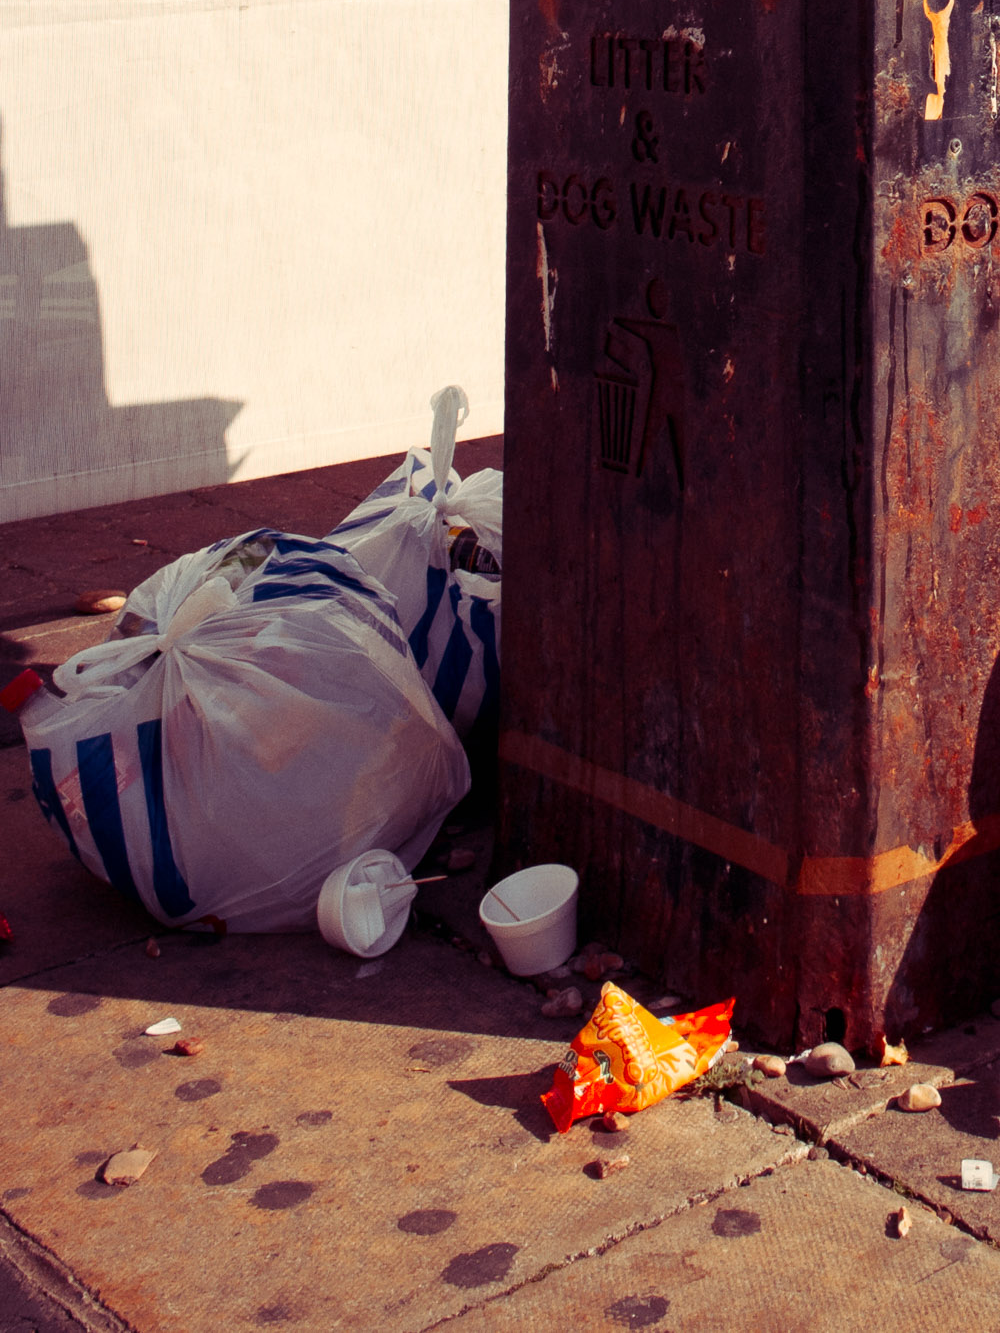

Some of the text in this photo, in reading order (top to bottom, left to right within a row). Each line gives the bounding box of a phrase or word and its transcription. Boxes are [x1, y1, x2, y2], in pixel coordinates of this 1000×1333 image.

[590, 35, 707, 94] LITTER
[632, 110, 658, 164] &
[536, 170, 767, 256] DOG WASTE
